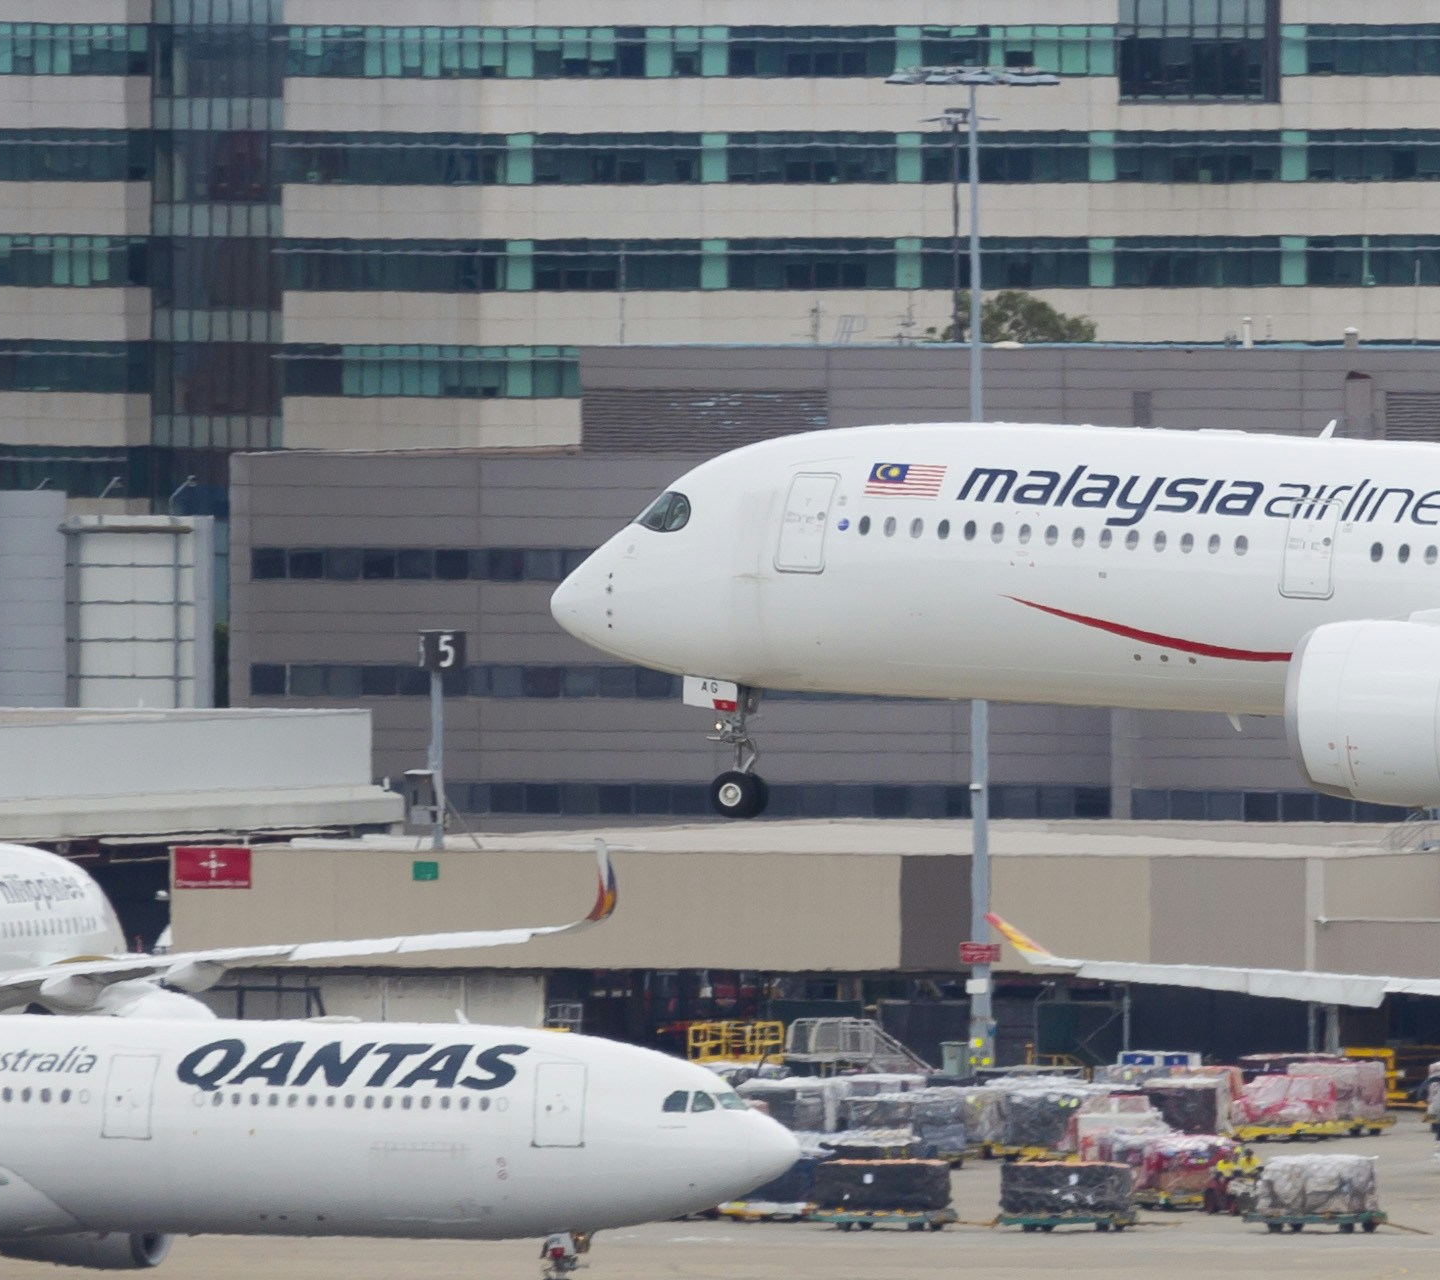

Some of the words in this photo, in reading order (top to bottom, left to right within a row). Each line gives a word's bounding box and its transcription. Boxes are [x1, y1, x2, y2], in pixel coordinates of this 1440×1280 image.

[957, 465, 1264, 526] malaysia
[439, 634, 455, 668] 5
[701, 681, 718, 694] AG
[177, 1039, 530, 1091] QANTAS
